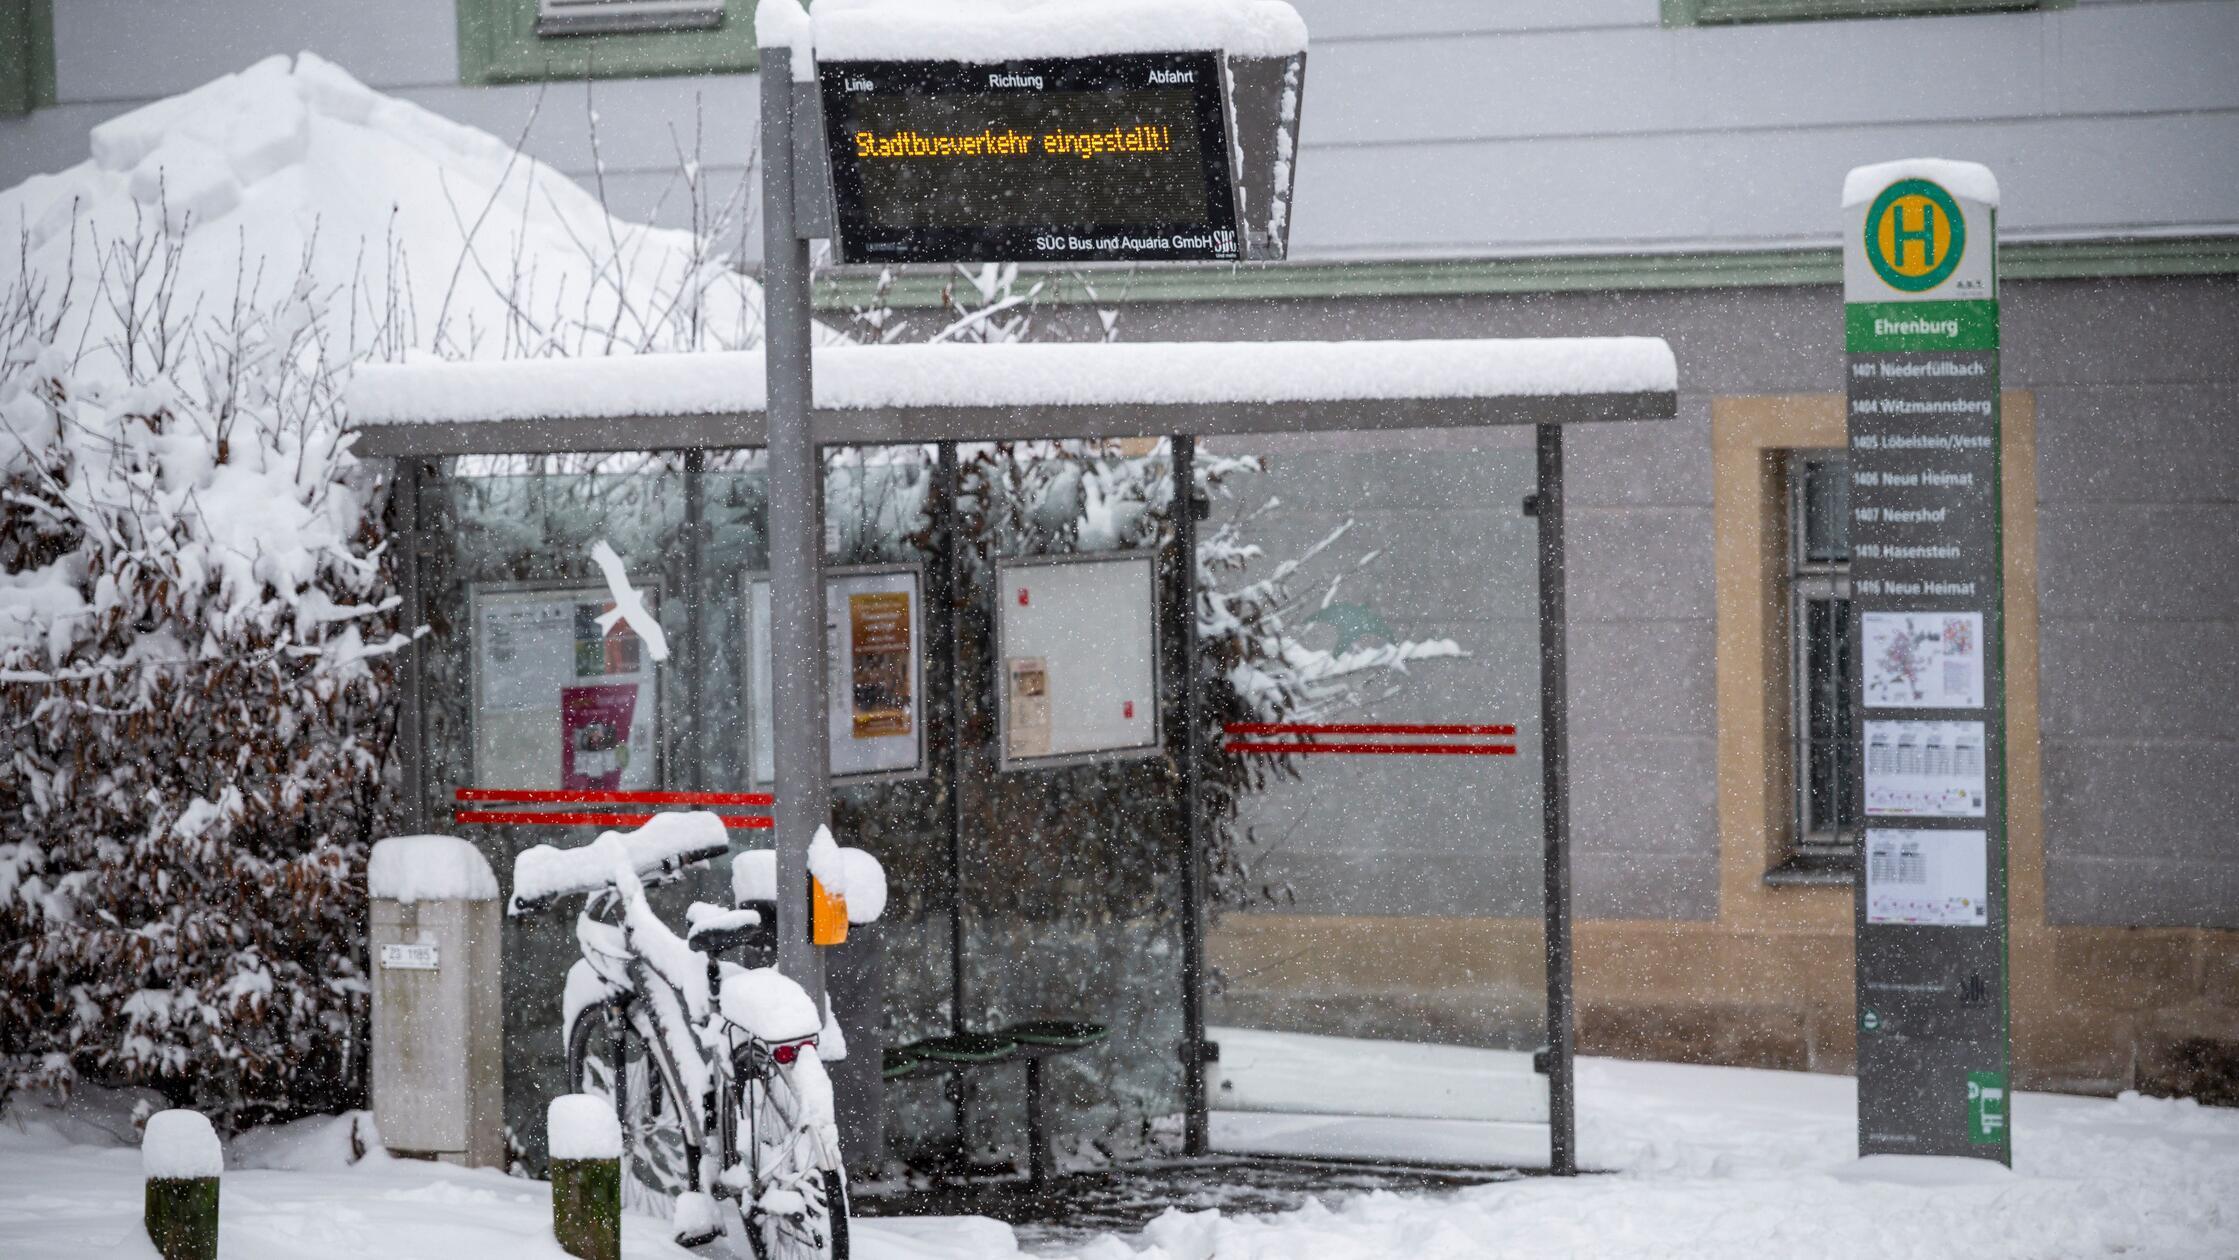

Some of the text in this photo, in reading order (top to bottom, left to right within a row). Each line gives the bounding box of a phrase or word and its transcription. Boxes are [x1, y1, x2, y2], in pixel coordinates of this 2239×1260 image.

[845, 70, 1194, 92] Linie Richtung Abfahrt
[856, 126, 1169, 159] Stadtbusverkehr eingestellt!
[1036, 235, 1212, 251] SÜC Bus und Aquaria GmbH
[1893, 204, 1934, 266] H
[1874, 318, 1958, 337] Ehrenburg
[1880, 361, 1984, 377] Niederfüllbach
[1881, 399, 1992, 416] Witzmannsberg
[1882, 471, 1918, 486] Neue
[1921, 471, 1973, 486] Heimat
[1883, 506, 1946, 522] Neershof
[1883, 543, 1961, 559] Hasenstein
[1884, 580, 1920, 595] Neue
[1922, 580, 1975, 596] Heimat
